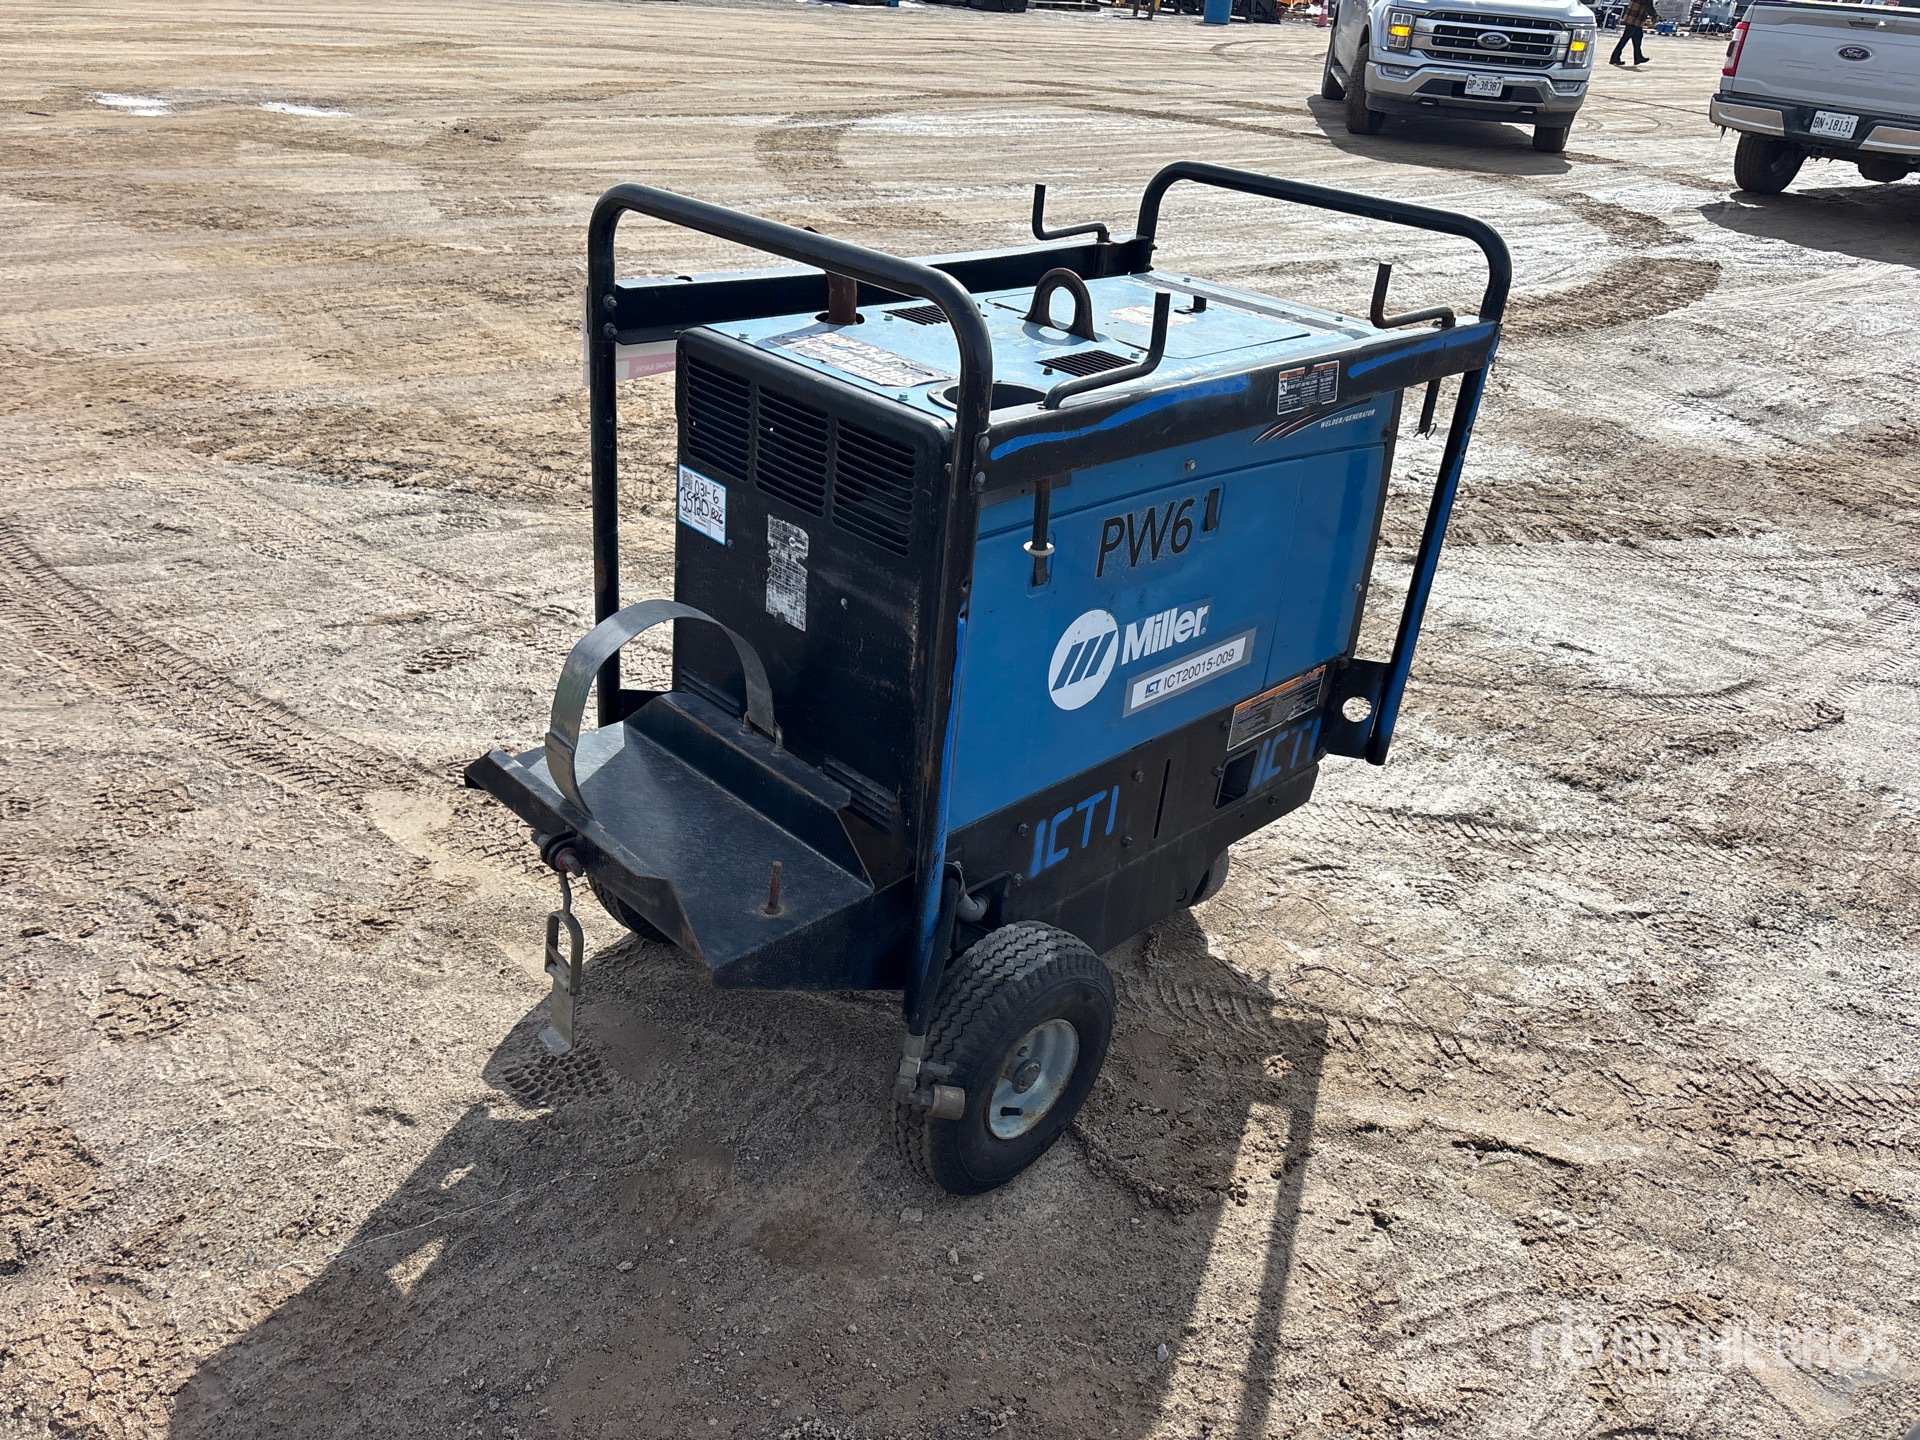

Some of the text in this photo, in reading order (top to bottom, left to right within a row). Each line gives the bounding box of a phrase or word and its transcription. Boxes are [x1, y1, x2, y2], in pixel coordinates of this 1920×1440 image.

[1843, 48, 1864, 58] Ford
[1320, 408, 1376, 429] WELDER/GENERATOR
[1121, 604, 1210, 666] Miller
[1163, 648, 1235, 690] ICT20015-009
